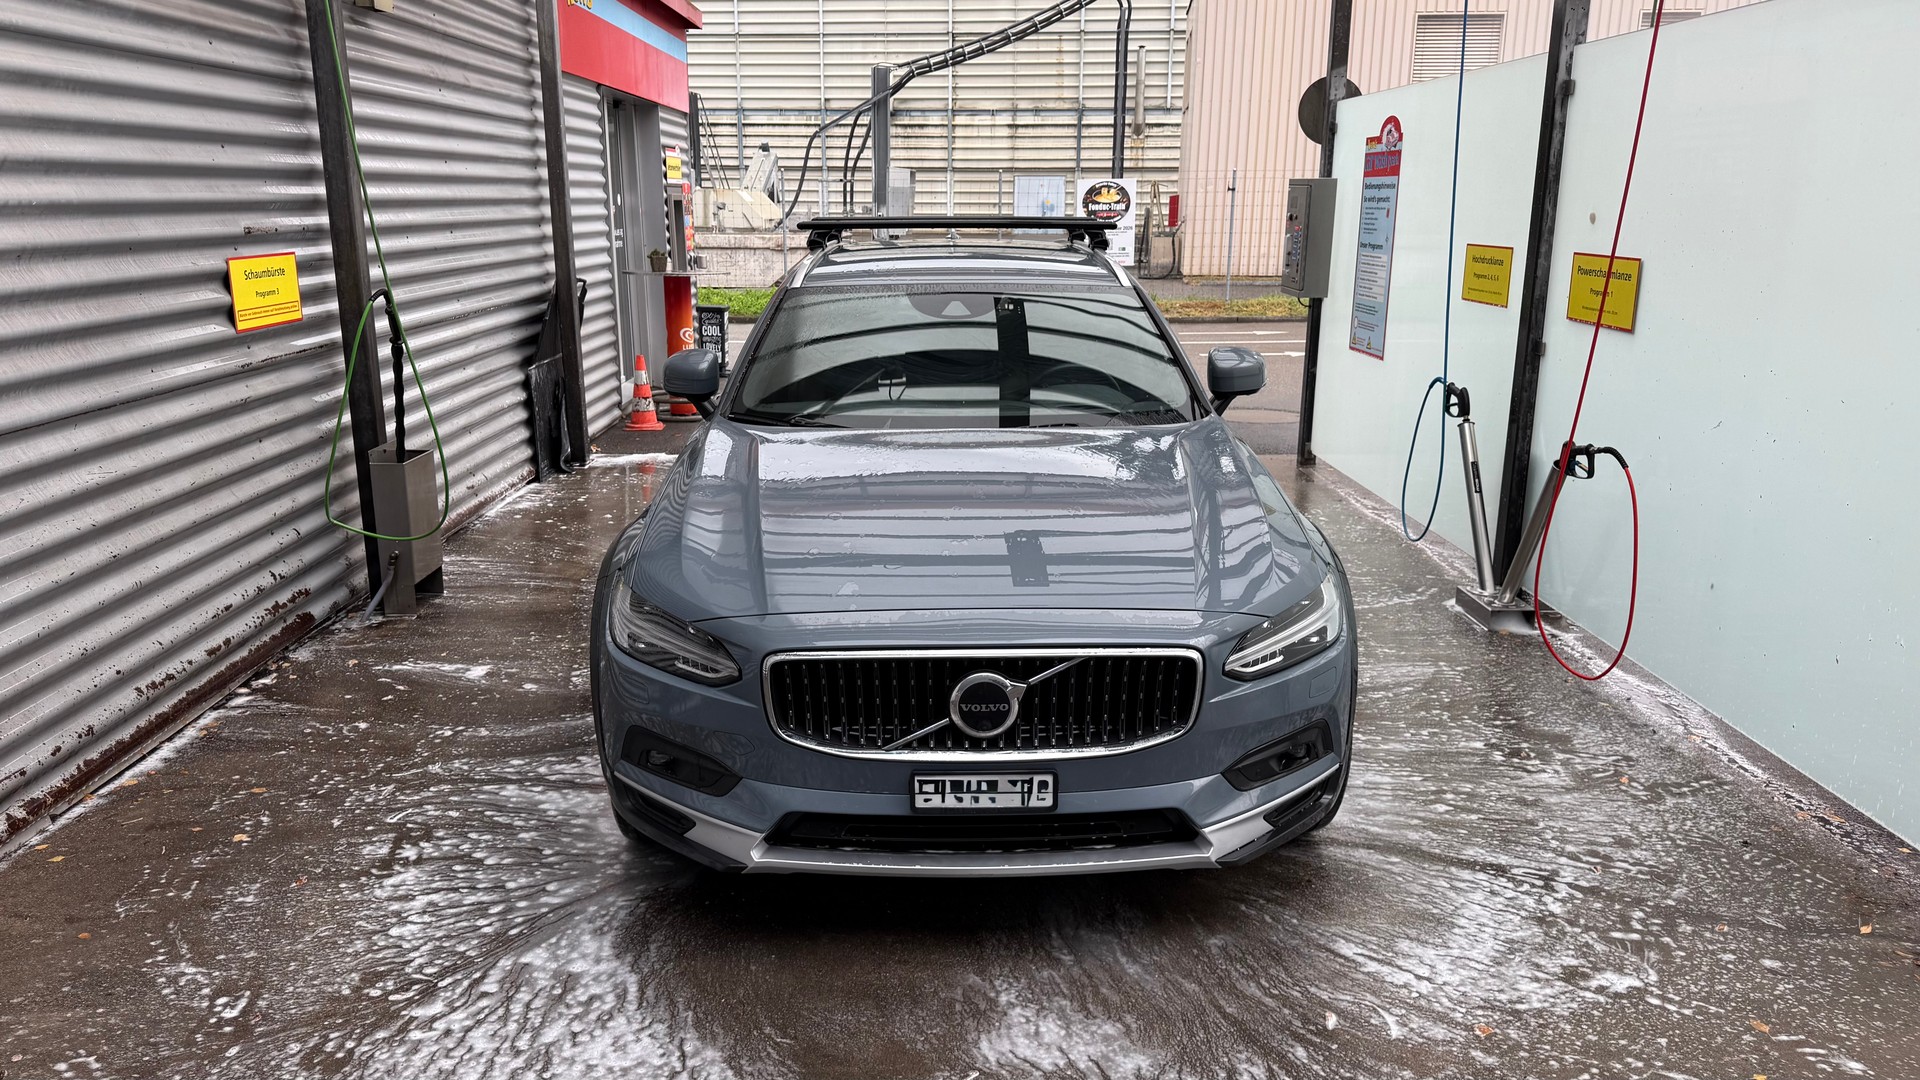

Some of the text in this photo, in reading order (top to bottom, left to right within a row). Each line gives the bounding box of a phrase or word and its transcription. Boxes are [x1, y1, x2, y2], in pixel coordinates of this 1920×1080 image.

[1364, 182, 1396, 191] Bedienungshinweise
[1471, 254, 1504, 267] Hochdrucklanze
[244, 266, 286, 280] Schaumbürste
[1577, 265, 1633, 281] Powerschamlanze
[256, 290, 276, 298] Programm
[702, 325, 722, 336] COOL
[703, 342, 722, 352] LOVELY
[959, 703, 1009, 712] VOLVO
